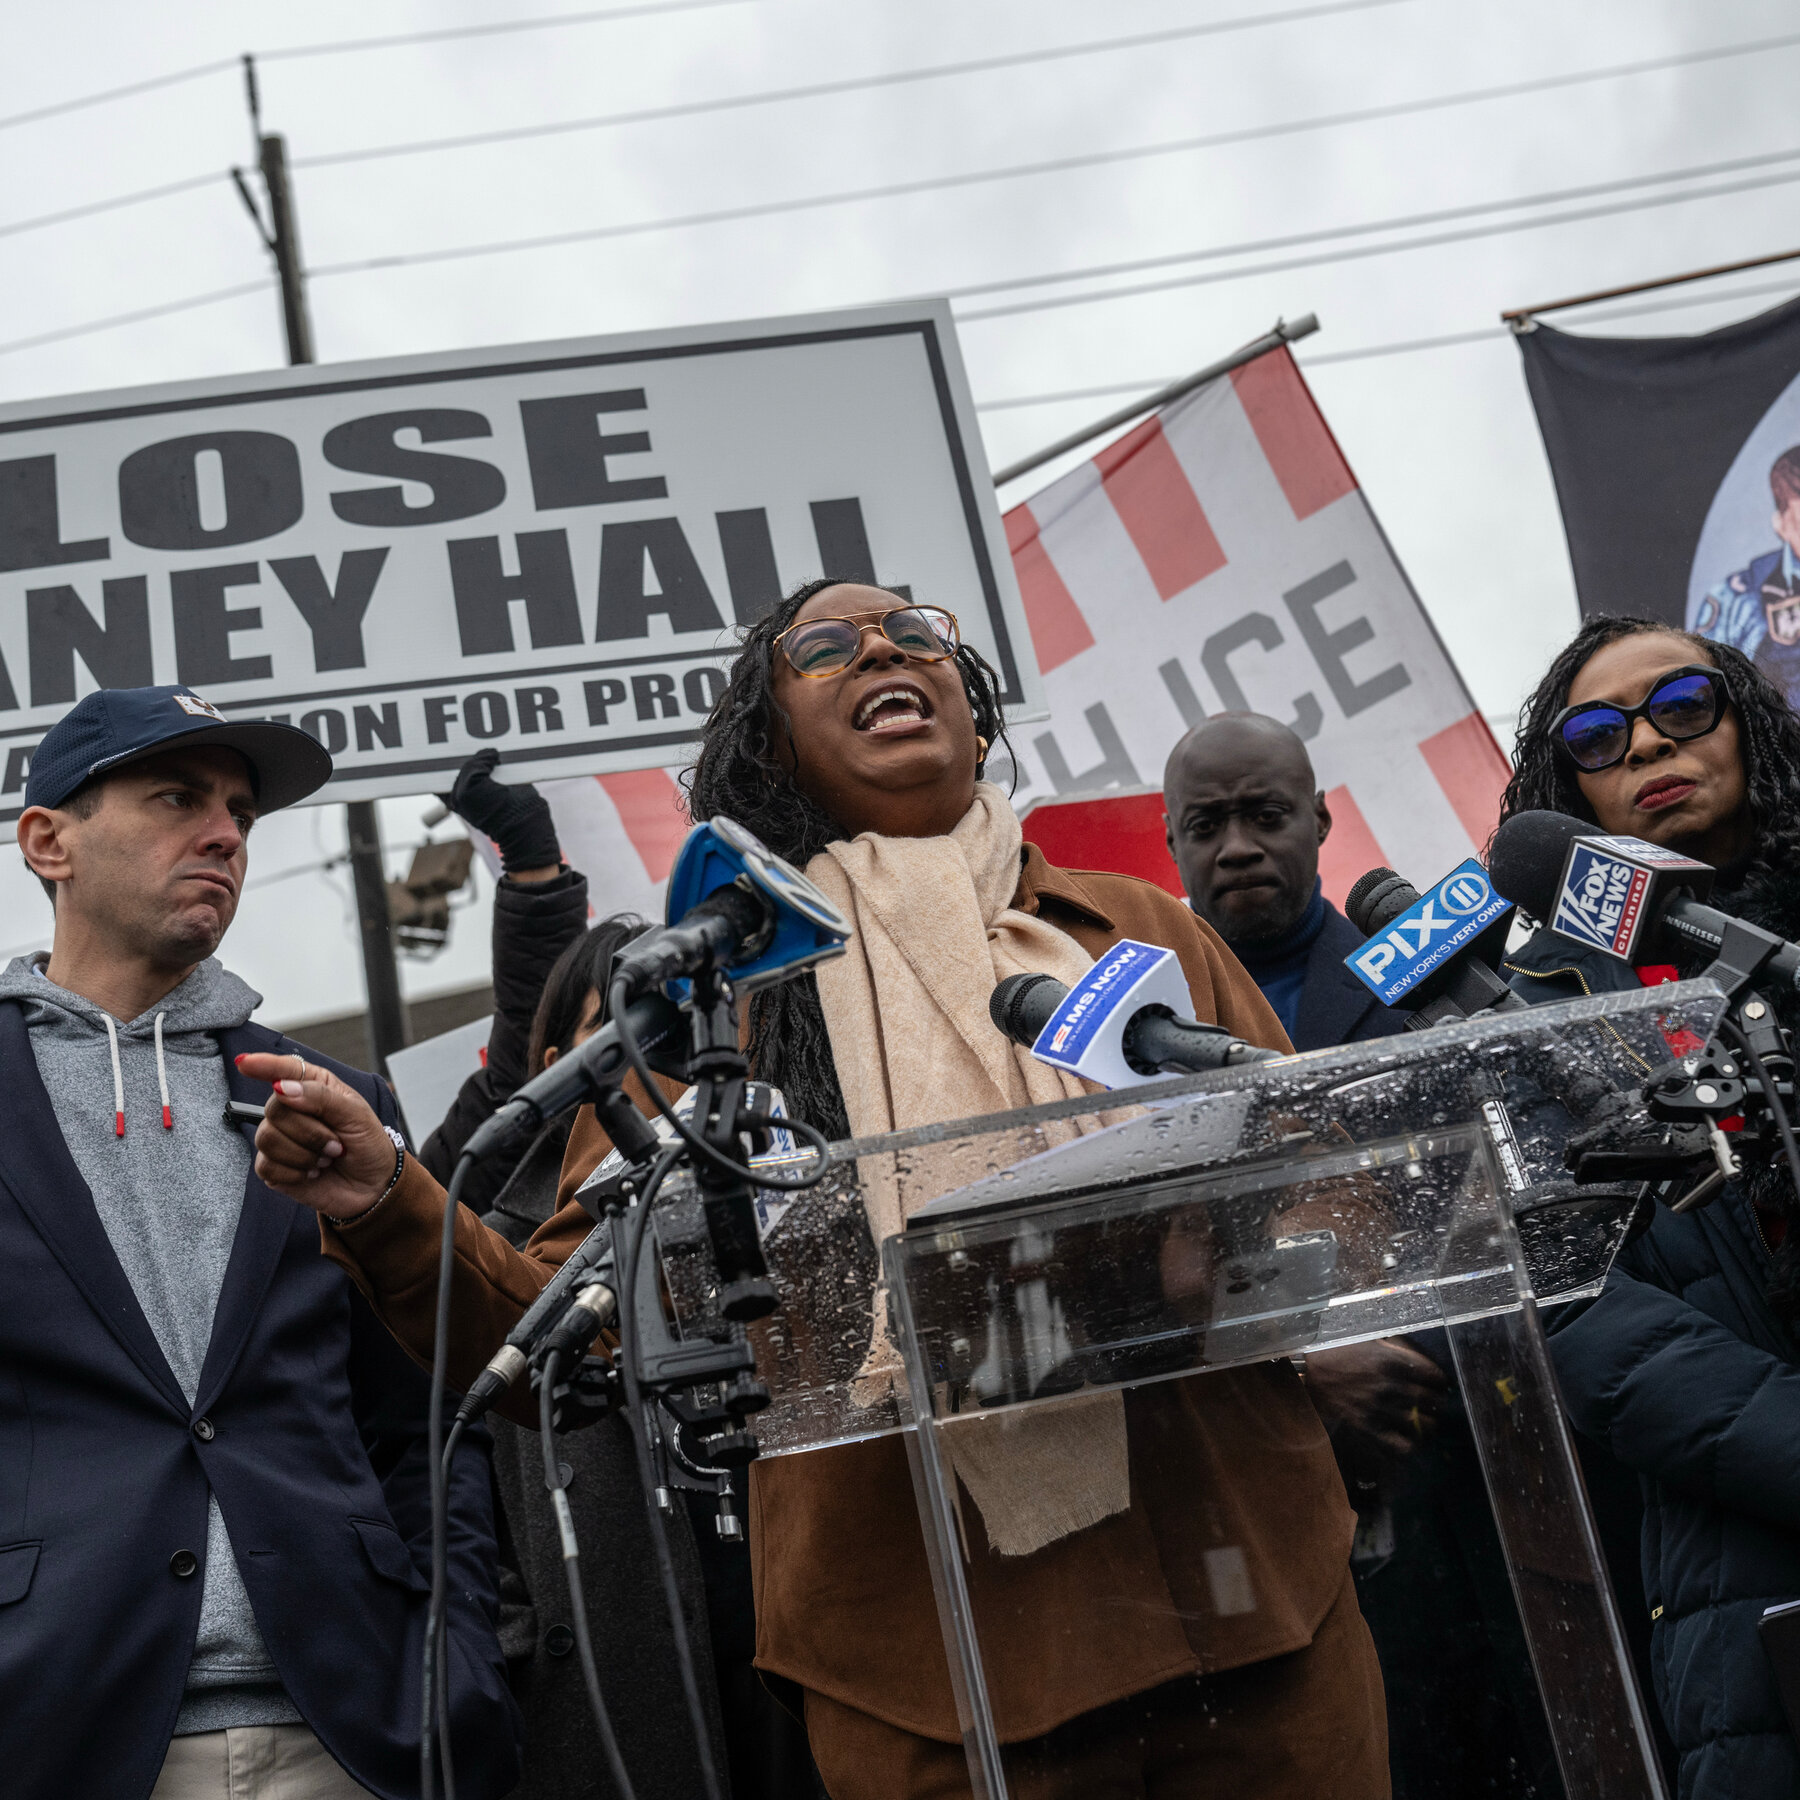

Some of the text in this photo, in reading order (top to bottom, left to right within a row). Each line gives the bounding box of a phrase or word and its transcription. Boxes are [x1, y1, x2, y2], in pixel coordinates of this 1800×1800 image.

[1158, 558, 1413, 744] ICE
[423, 687, 565, 745] FOR
[1578, 857, 1632, 937] FOX NEWS
[1617, 873, 1646, 951] channel
[1355, 898, 1457, 986] PIX
[1384, 977, 1412, 999] NEW
[1409, 943, 1451, 978] YORK'S
[1448, 920, 1479, 945] VERY
[1477, 898, 1506, 922] OWN
[1066, 948, 1137, 1024] MS NOW
